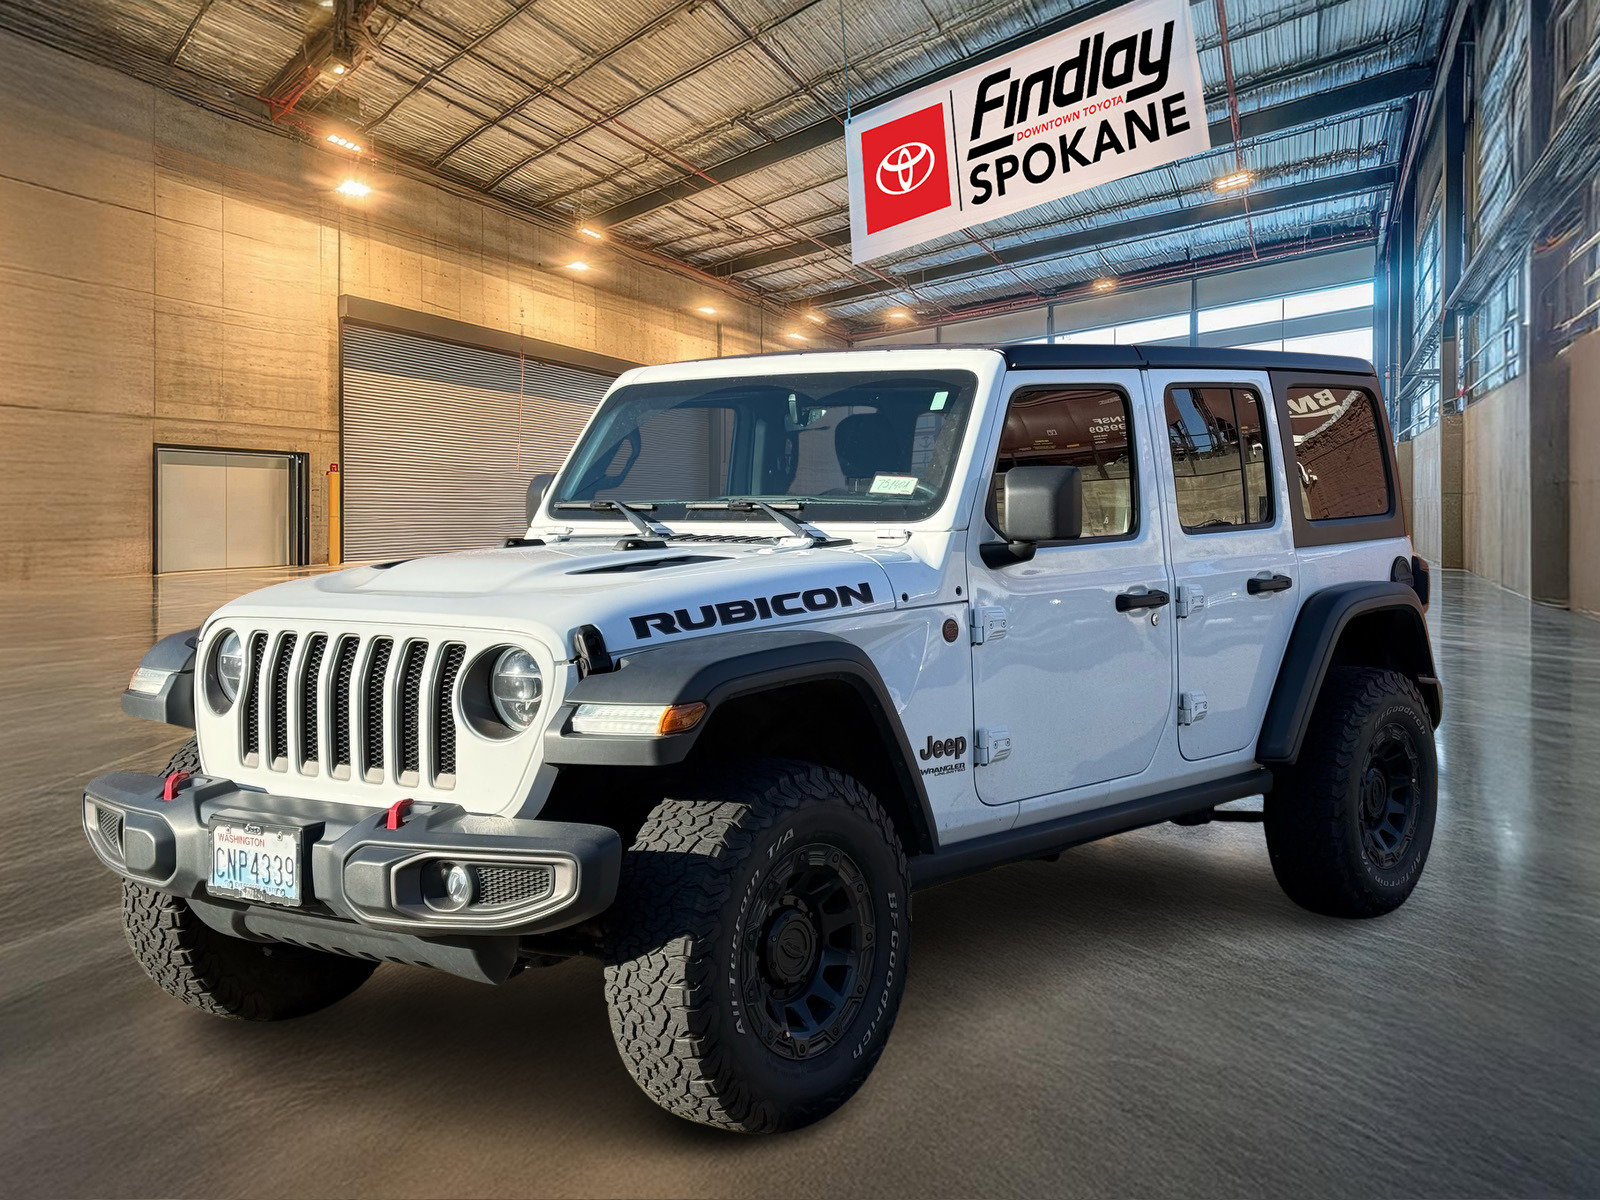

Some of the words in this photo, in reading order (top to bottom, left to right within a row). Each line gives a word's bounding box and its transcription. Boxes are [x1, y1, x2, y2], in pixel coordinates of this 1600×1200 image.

[968, 20, 1175, 142] Findlay
[1017, 110, 1080, 141] DOWNTOWN
[1083, 95, 1124, 116] TOYOTA
[968, 91, 1191, 205] SPOKANE
[629, 582, 875, 639] RUBICON
[919, 735, 967, 761] Jeep
[920, 762, 966, 776] WRANGLER
[218, 833, 265, 847] WASHINGTON
[765, 827, 795, 859] T/A
[216, 847, 294, 888] CNP4339
[851, 891, 901, 1060] BFGoodrich
